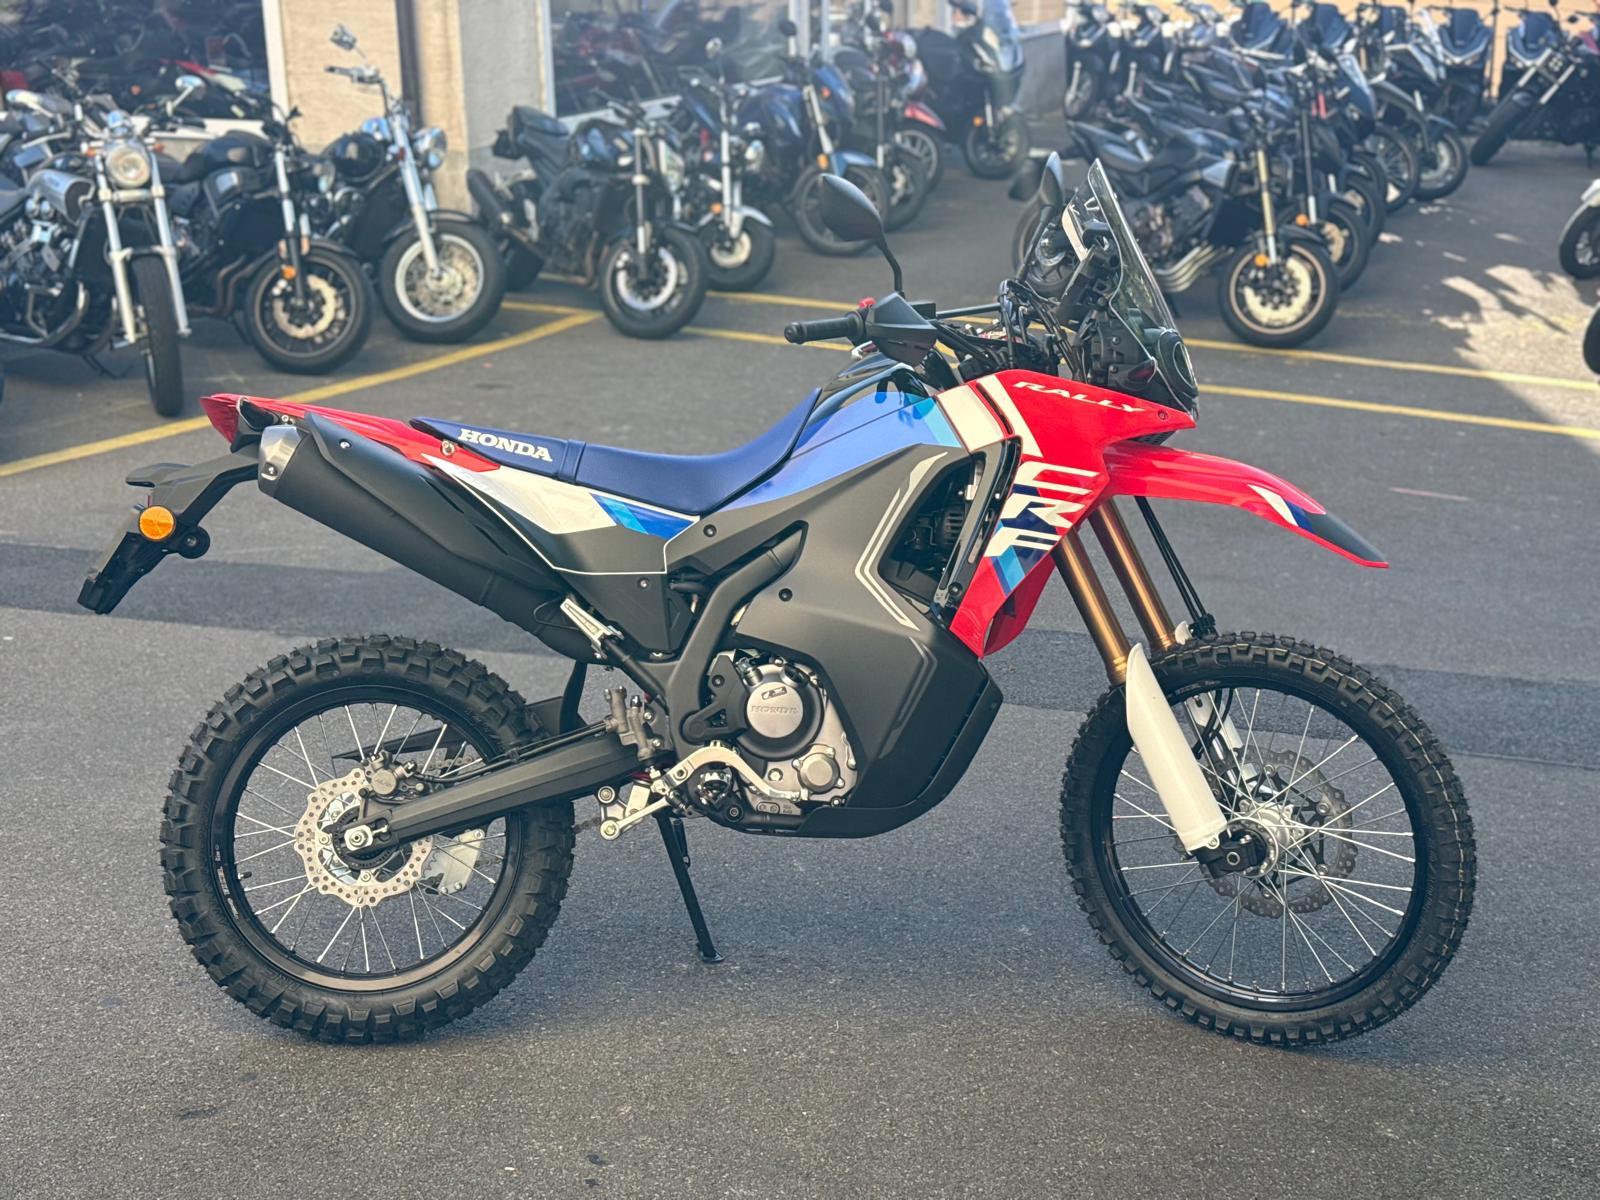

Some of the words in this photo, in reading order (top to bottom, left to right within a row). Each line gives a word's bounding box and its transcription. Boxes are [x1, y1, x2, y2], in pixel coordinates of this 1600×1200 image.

[1013, 381, 1146, 412] RALLY
[458, 428, 553, 462] HONDA
[983, 460, 1100, 557] CRF
[750, 704, 799, 715] HONDA
